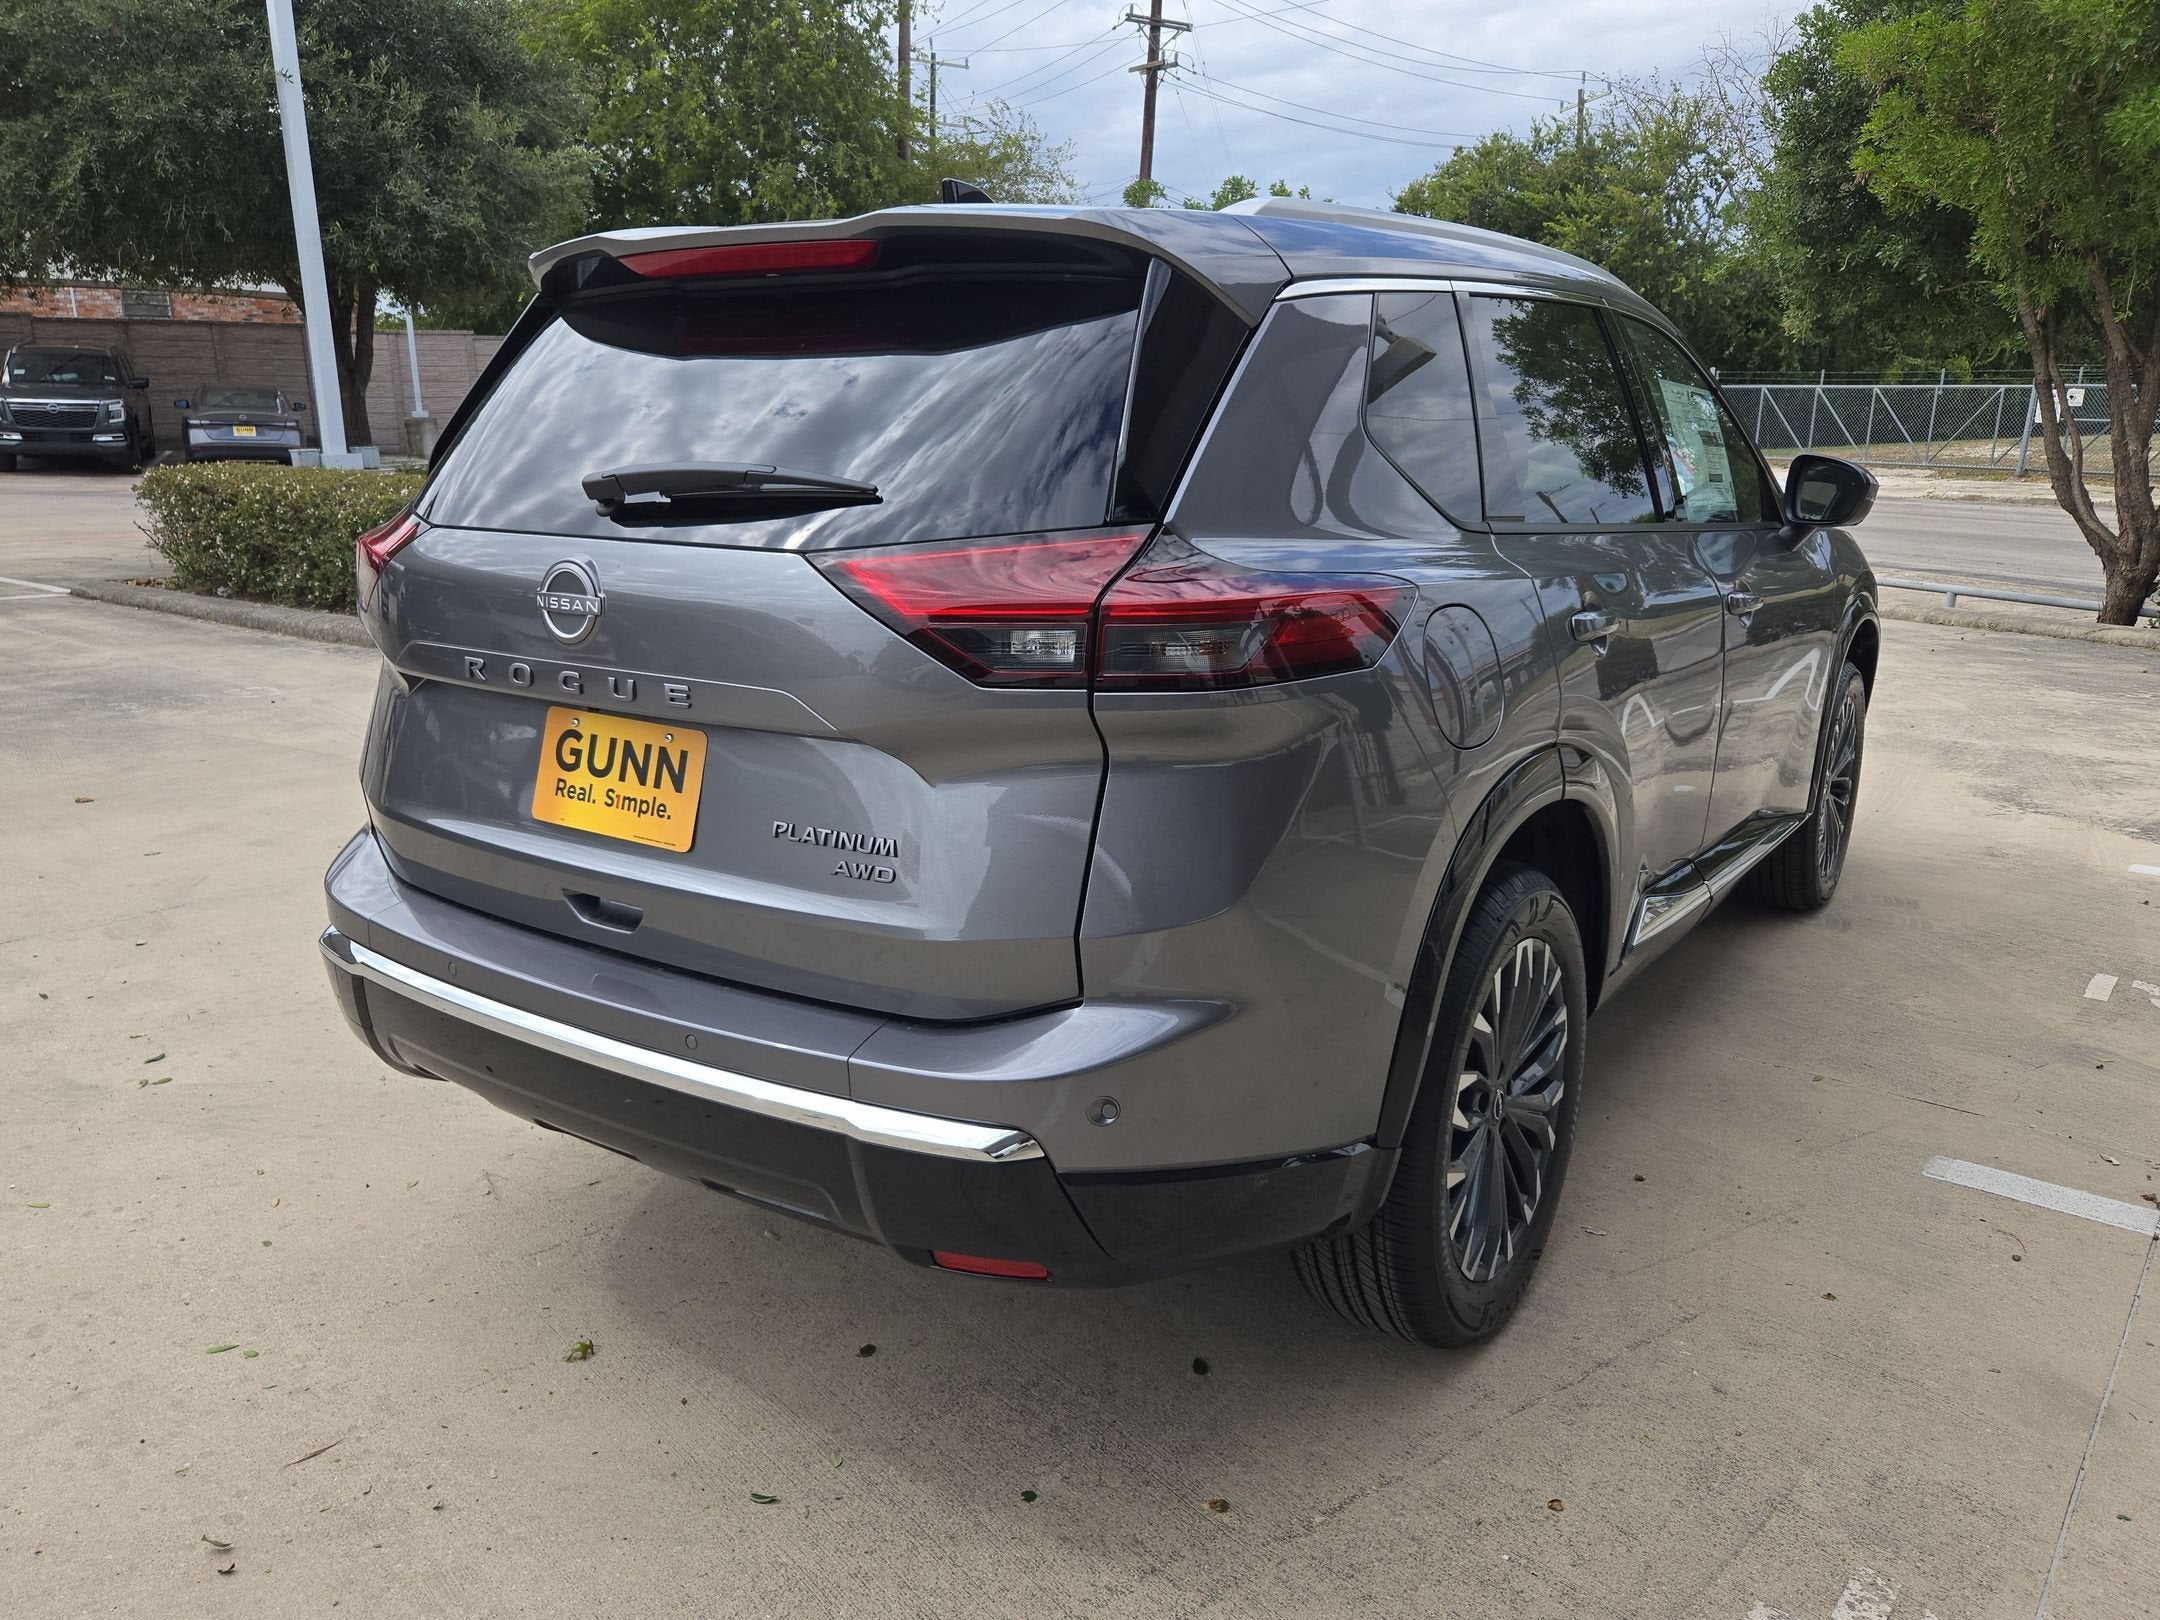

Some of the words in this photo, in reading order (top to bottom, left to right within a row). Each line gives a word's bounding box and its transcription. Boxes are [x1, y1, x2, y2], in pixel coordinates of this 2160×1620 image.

[536, 595, 598, 613] NISSAN
[464, 656, 691, 709] ROGUE
[555, 728, 689, 794] GUNN
[555, 777, 596, 804] Real.
[772, 820, 898, 858] PLATINUM
[830, 860, 897, 884] AWD
